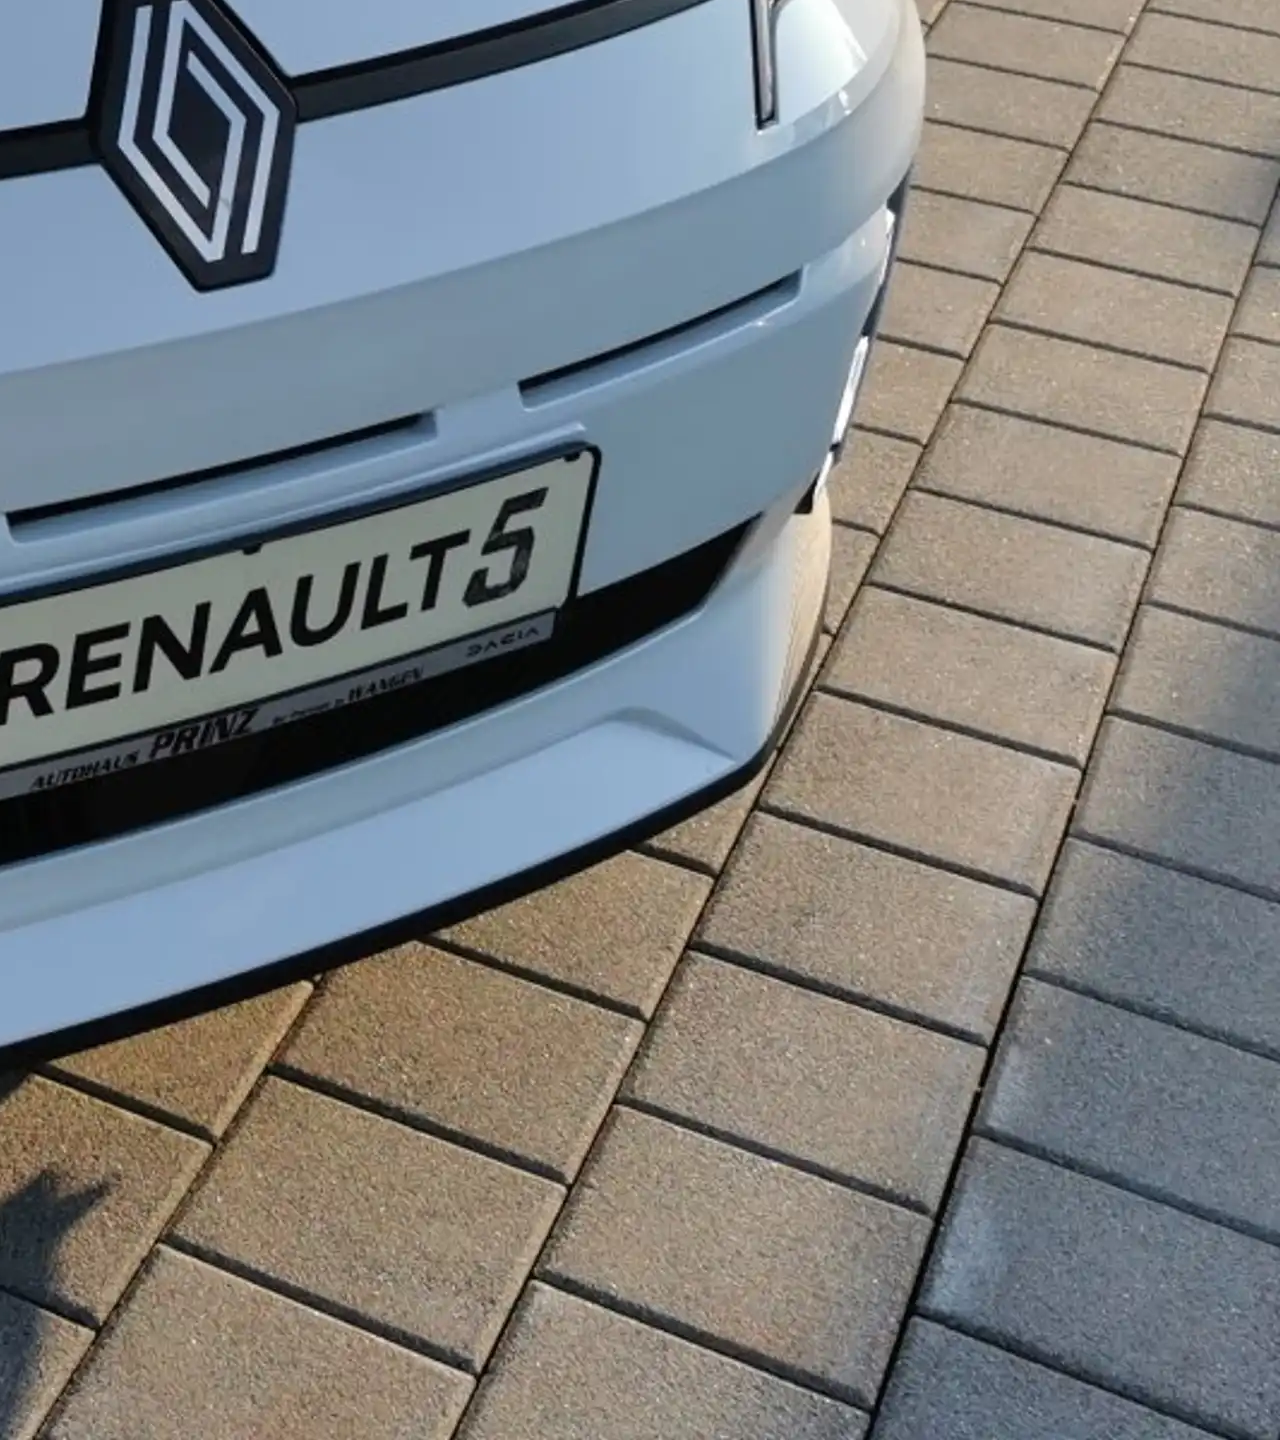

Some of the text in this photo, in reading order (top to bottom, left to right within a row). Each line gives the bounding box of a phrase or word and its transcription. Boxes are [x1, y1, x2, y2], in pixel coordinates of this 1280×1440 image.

[462, 486, 549, 608] 5
[465, 627, 540, 658] DACIA
[149, 708, 260, 759] PRINZ
